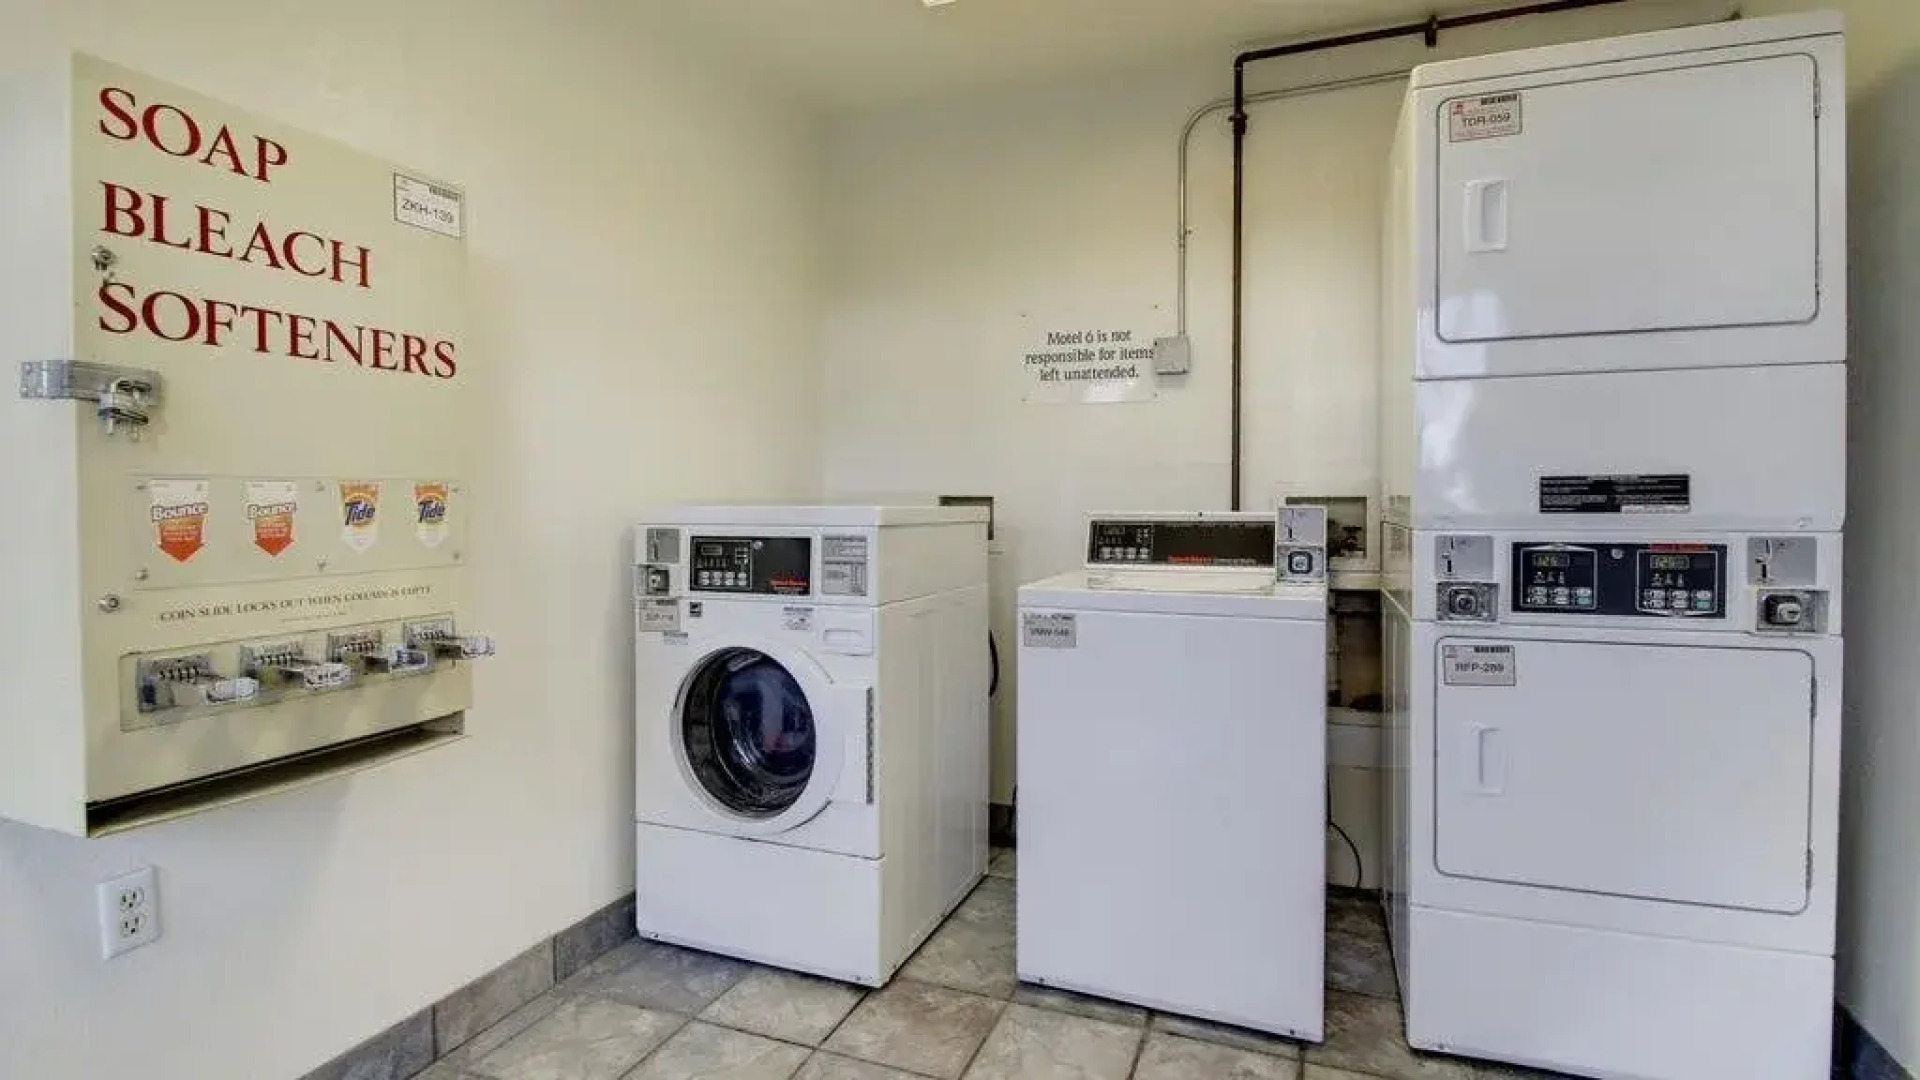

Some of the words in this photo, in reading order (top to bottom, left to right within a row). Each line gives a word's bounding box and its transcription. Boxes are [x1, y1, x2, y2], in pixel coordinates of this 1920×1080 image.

[99, 87, 288, 182] SOAP
[402, 198, 454, 224] ZKH-139
[99, 181, 371, 287] BLEACH
[98, 282, 457, 379] SOFTENERS
[1048, 331, 1082, 345] Motel
[1085, 330, 1094, 343] 6
[1097, 330, 1107, 342] is
[1111, 329, 1131, 342] not
[1025, 349, 1095, 367] responsible
[1099, 348, 1117, 361] for
[1119, 348, 1154, 361] items
[1040, 369, 1060, 382] left
[1064, 365, 1139, 380] unattended.
[152, 502, 208, 522] Bounce
[248, 502, 297, 519] Bounce
[345, 500, 375, 525] Tide
[418, 500, 445, 523] Tide
[160, 609, 196, 621] COIN
[237, 601, 277, 614] LOCKS
[308, 595, 342, 606] WHEN
